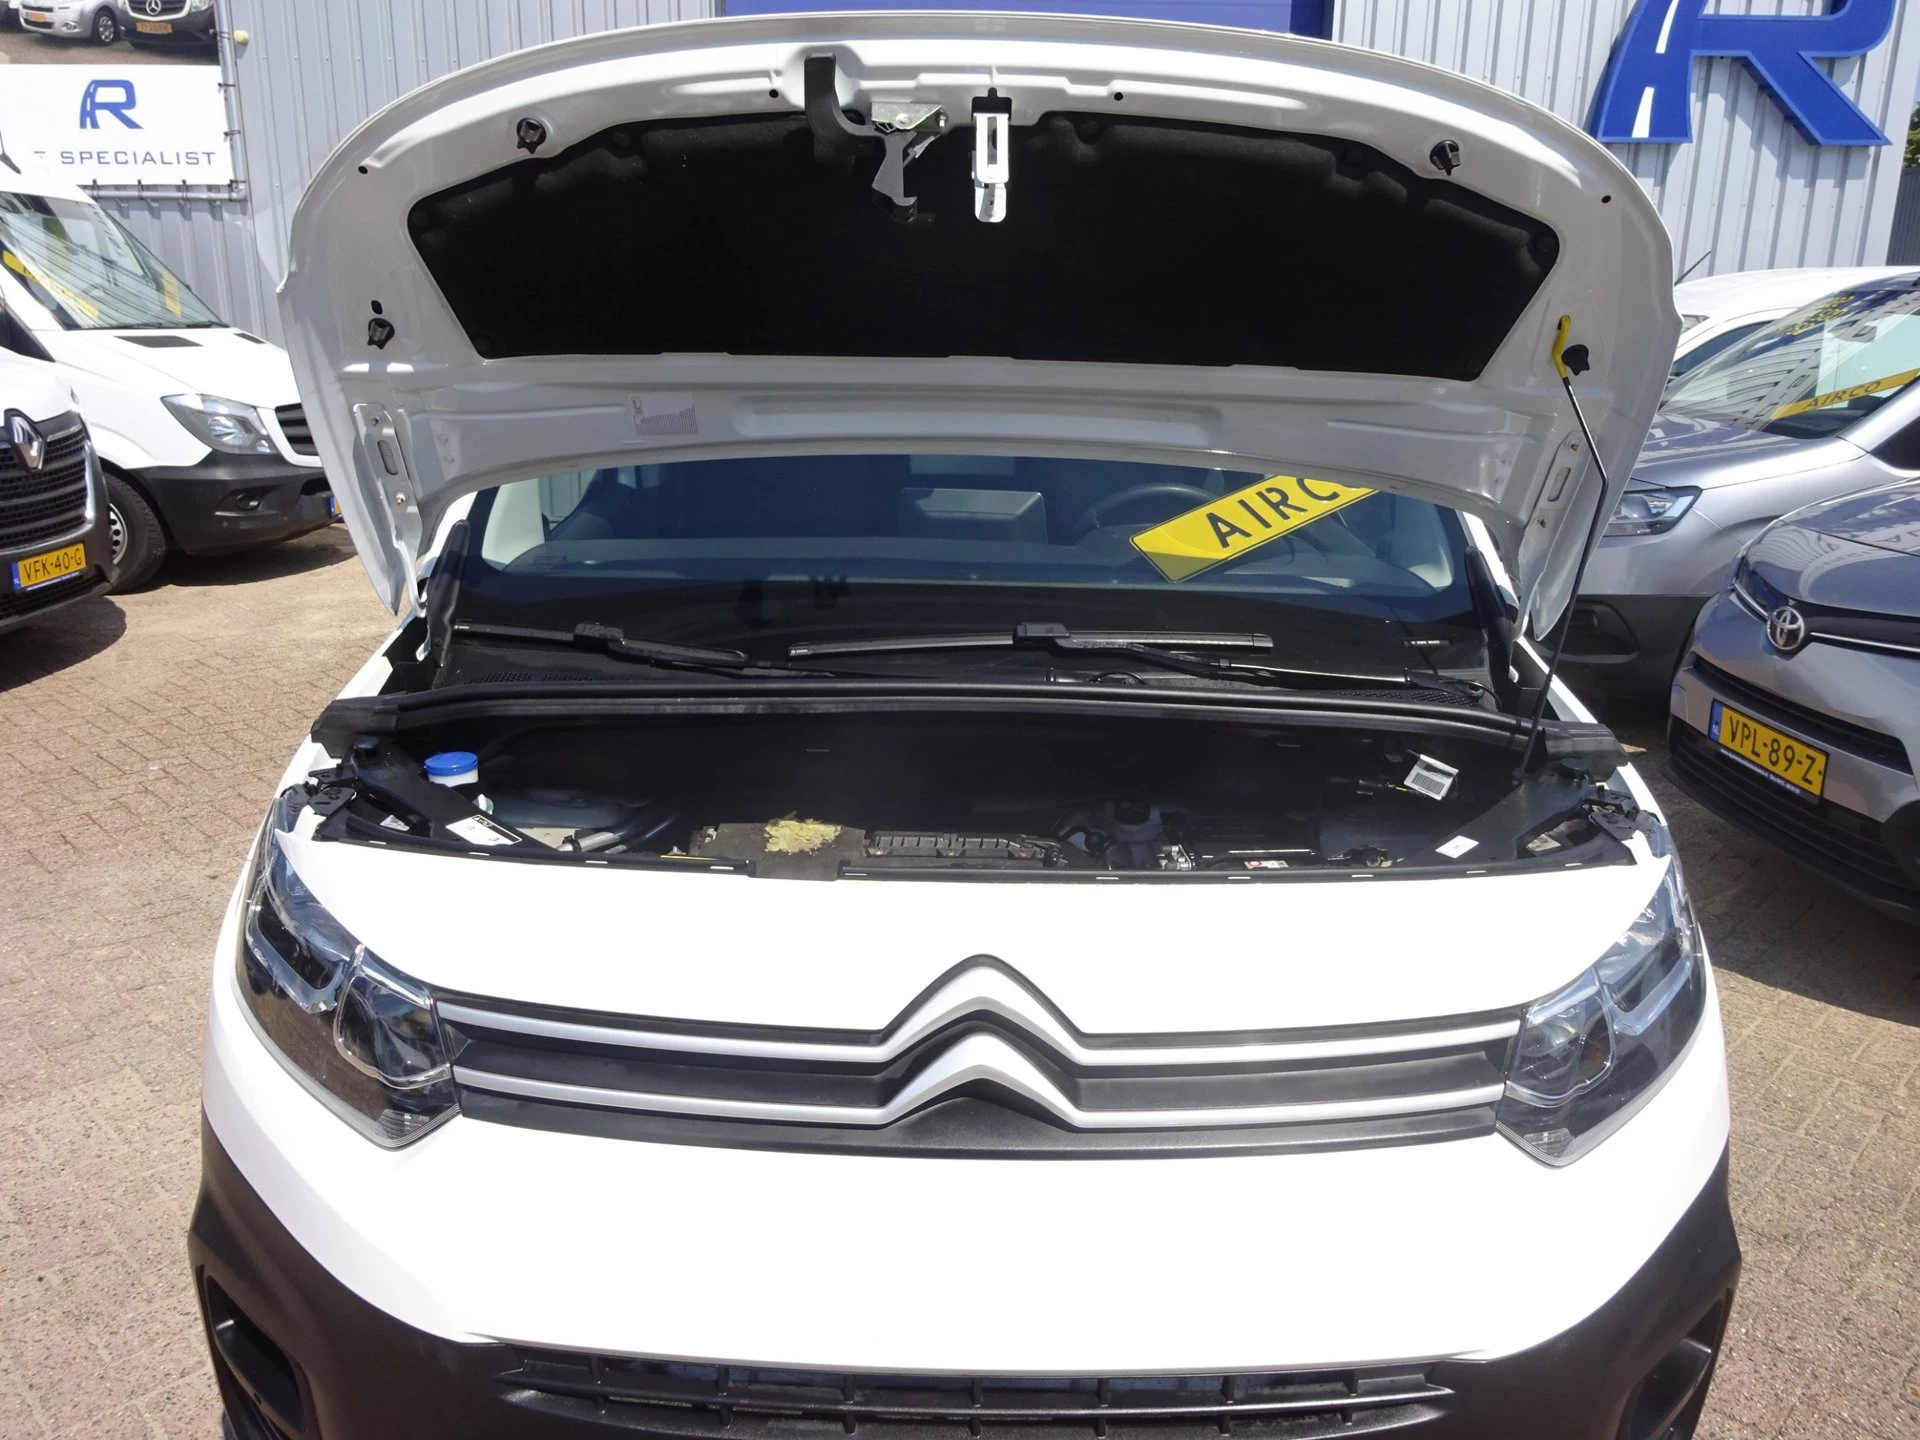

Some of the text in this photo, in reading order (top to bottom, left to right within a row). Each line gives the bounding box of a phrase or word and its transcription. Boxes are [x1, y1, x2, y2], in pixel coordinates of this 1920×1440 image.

[61, 151, 215, 165] SPECIALIST
[1803, 381, 1881, 410] AIRCO
[1206, 479, 1358, 549] AIRC
[23, 548, 82, 581] VFK-40-G
[1729, 715, 1816, 785] VPL-89-Z
